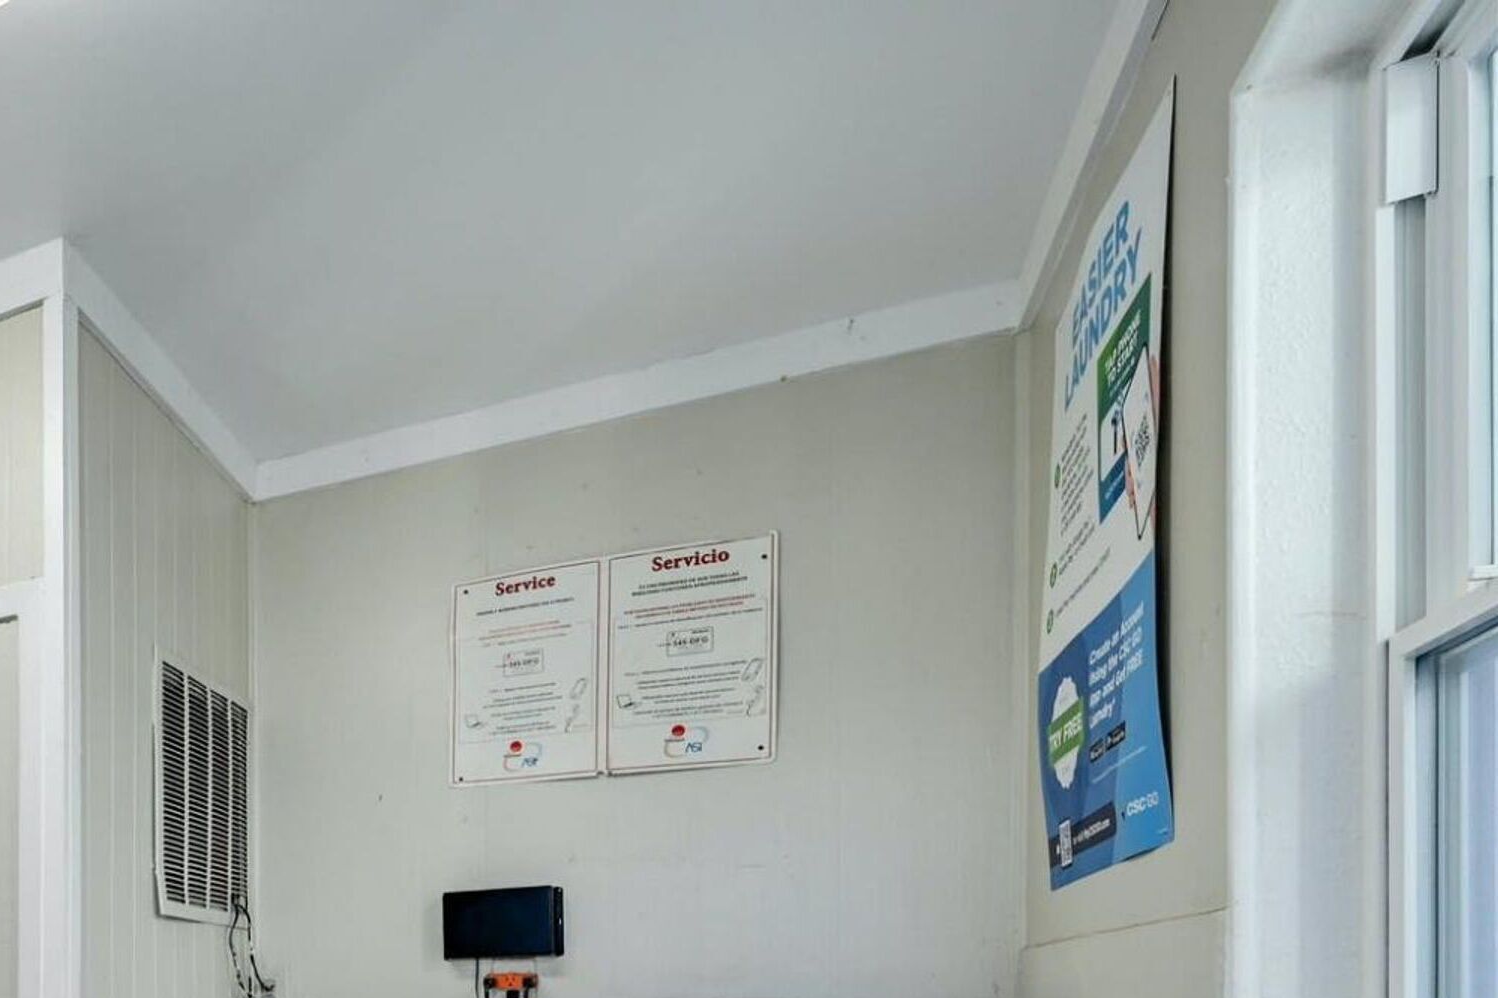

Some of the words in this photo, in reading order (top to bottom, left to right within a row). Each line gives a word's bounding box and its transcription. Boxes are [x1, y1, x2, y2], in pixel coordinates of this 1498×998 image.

[1073, 201, 1129, 350] EASIER
[1065, 227, 1141, 412] LAUNDRY
[651, 548, 731, 571] Servicio
[495, 575, 556, 596] Service
[1063, 711, 1083, 744] FREE
